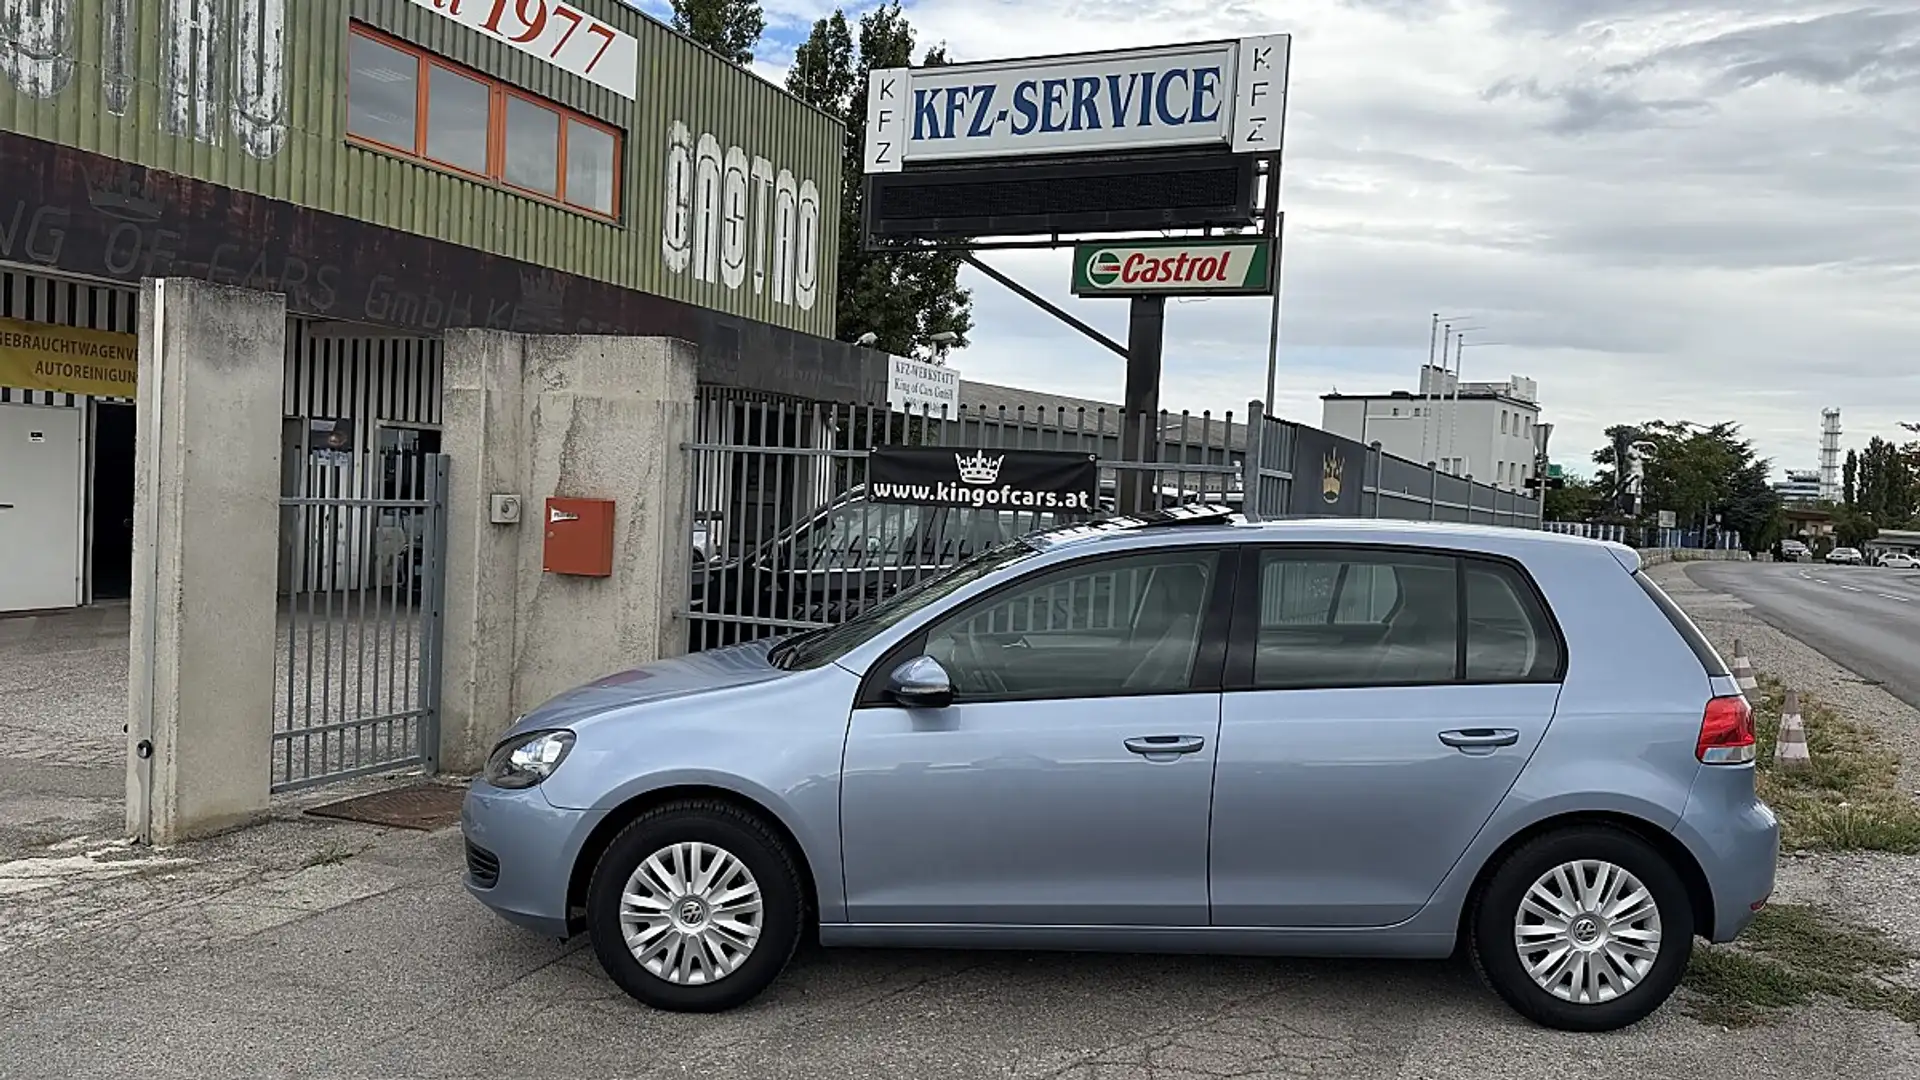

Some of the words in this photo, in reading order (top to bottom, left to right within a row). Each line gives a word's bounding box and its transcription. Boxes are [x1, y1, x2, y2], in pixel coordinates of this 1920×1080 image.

[478, 0, 616, 74] 1977
[911, 66, 1222, 140] KFZ-SERVICE
[1121, 251, 1231, 284] Castrol
[35, 360, 138, 384] AUTOREINIGUN
[873, 481, 1089, 508] www.kingofcars.at
